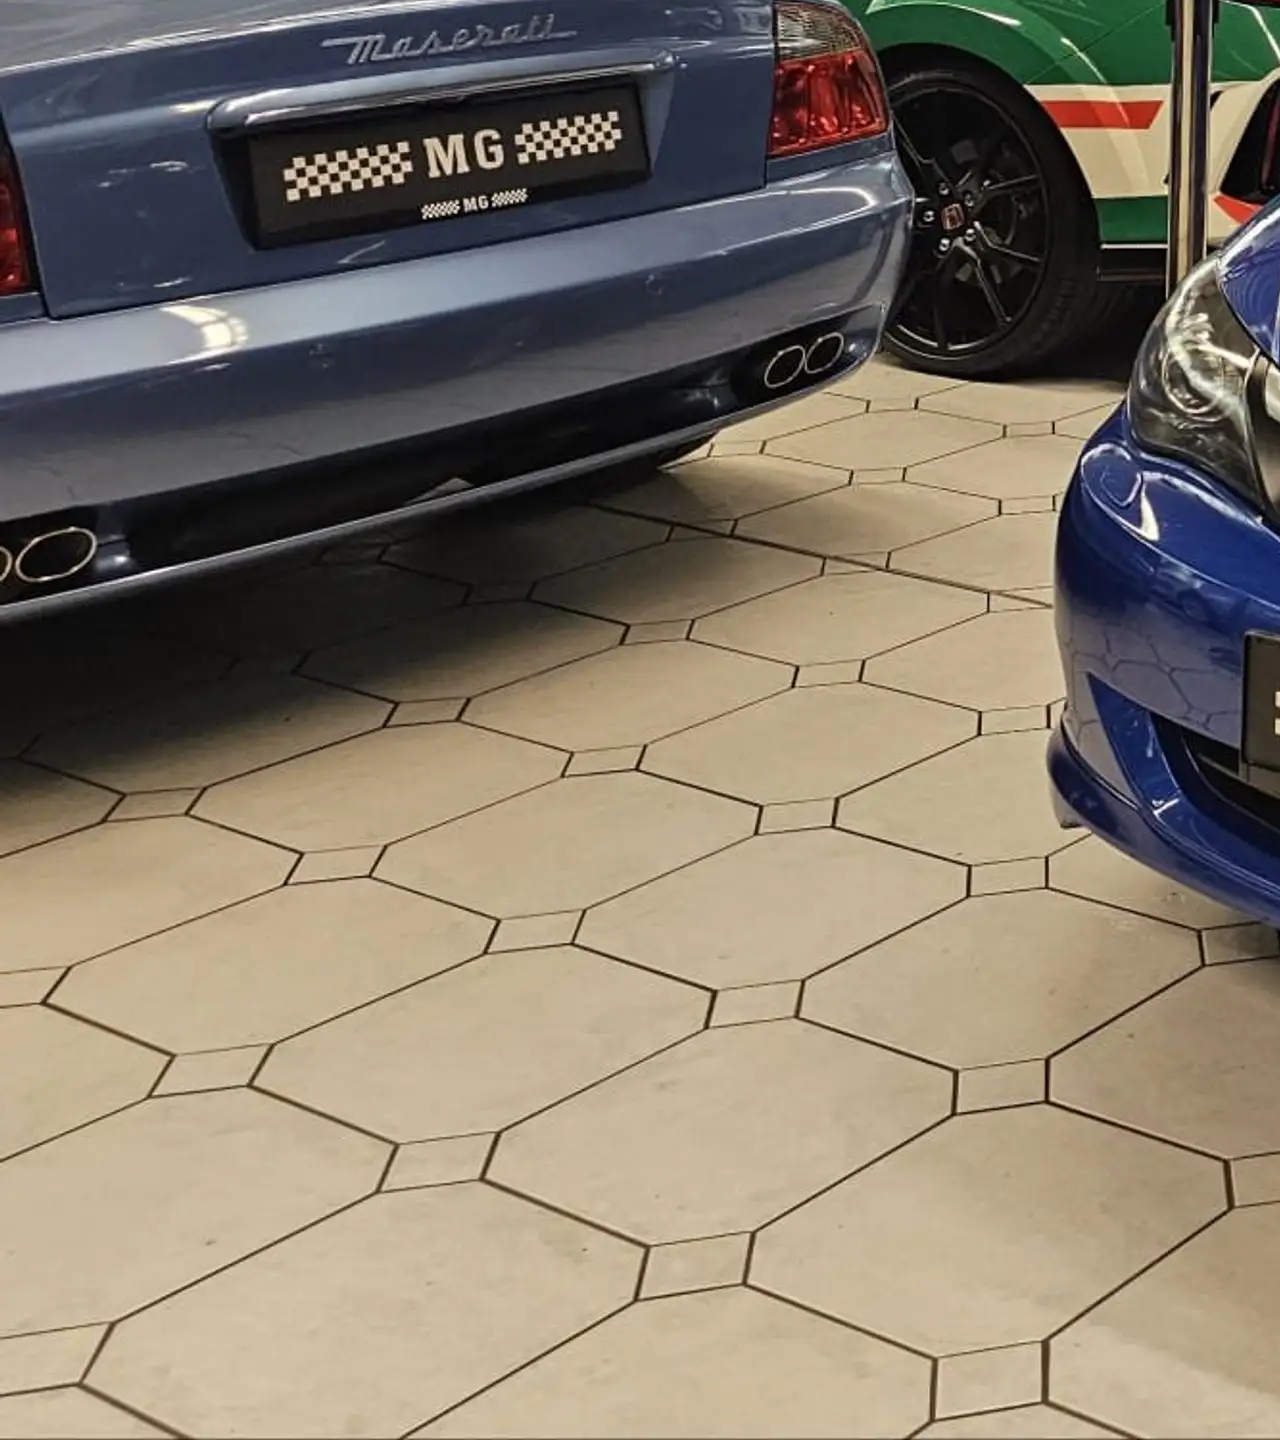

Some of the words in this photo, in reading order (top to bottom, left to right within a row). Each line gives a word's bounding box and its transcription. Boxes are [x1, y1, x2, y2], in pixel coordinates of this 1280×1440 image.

[322, 13, 578, 64] Maserati
[422, 127, 505, 180] MG
[463, 194, 490, 214] MG
